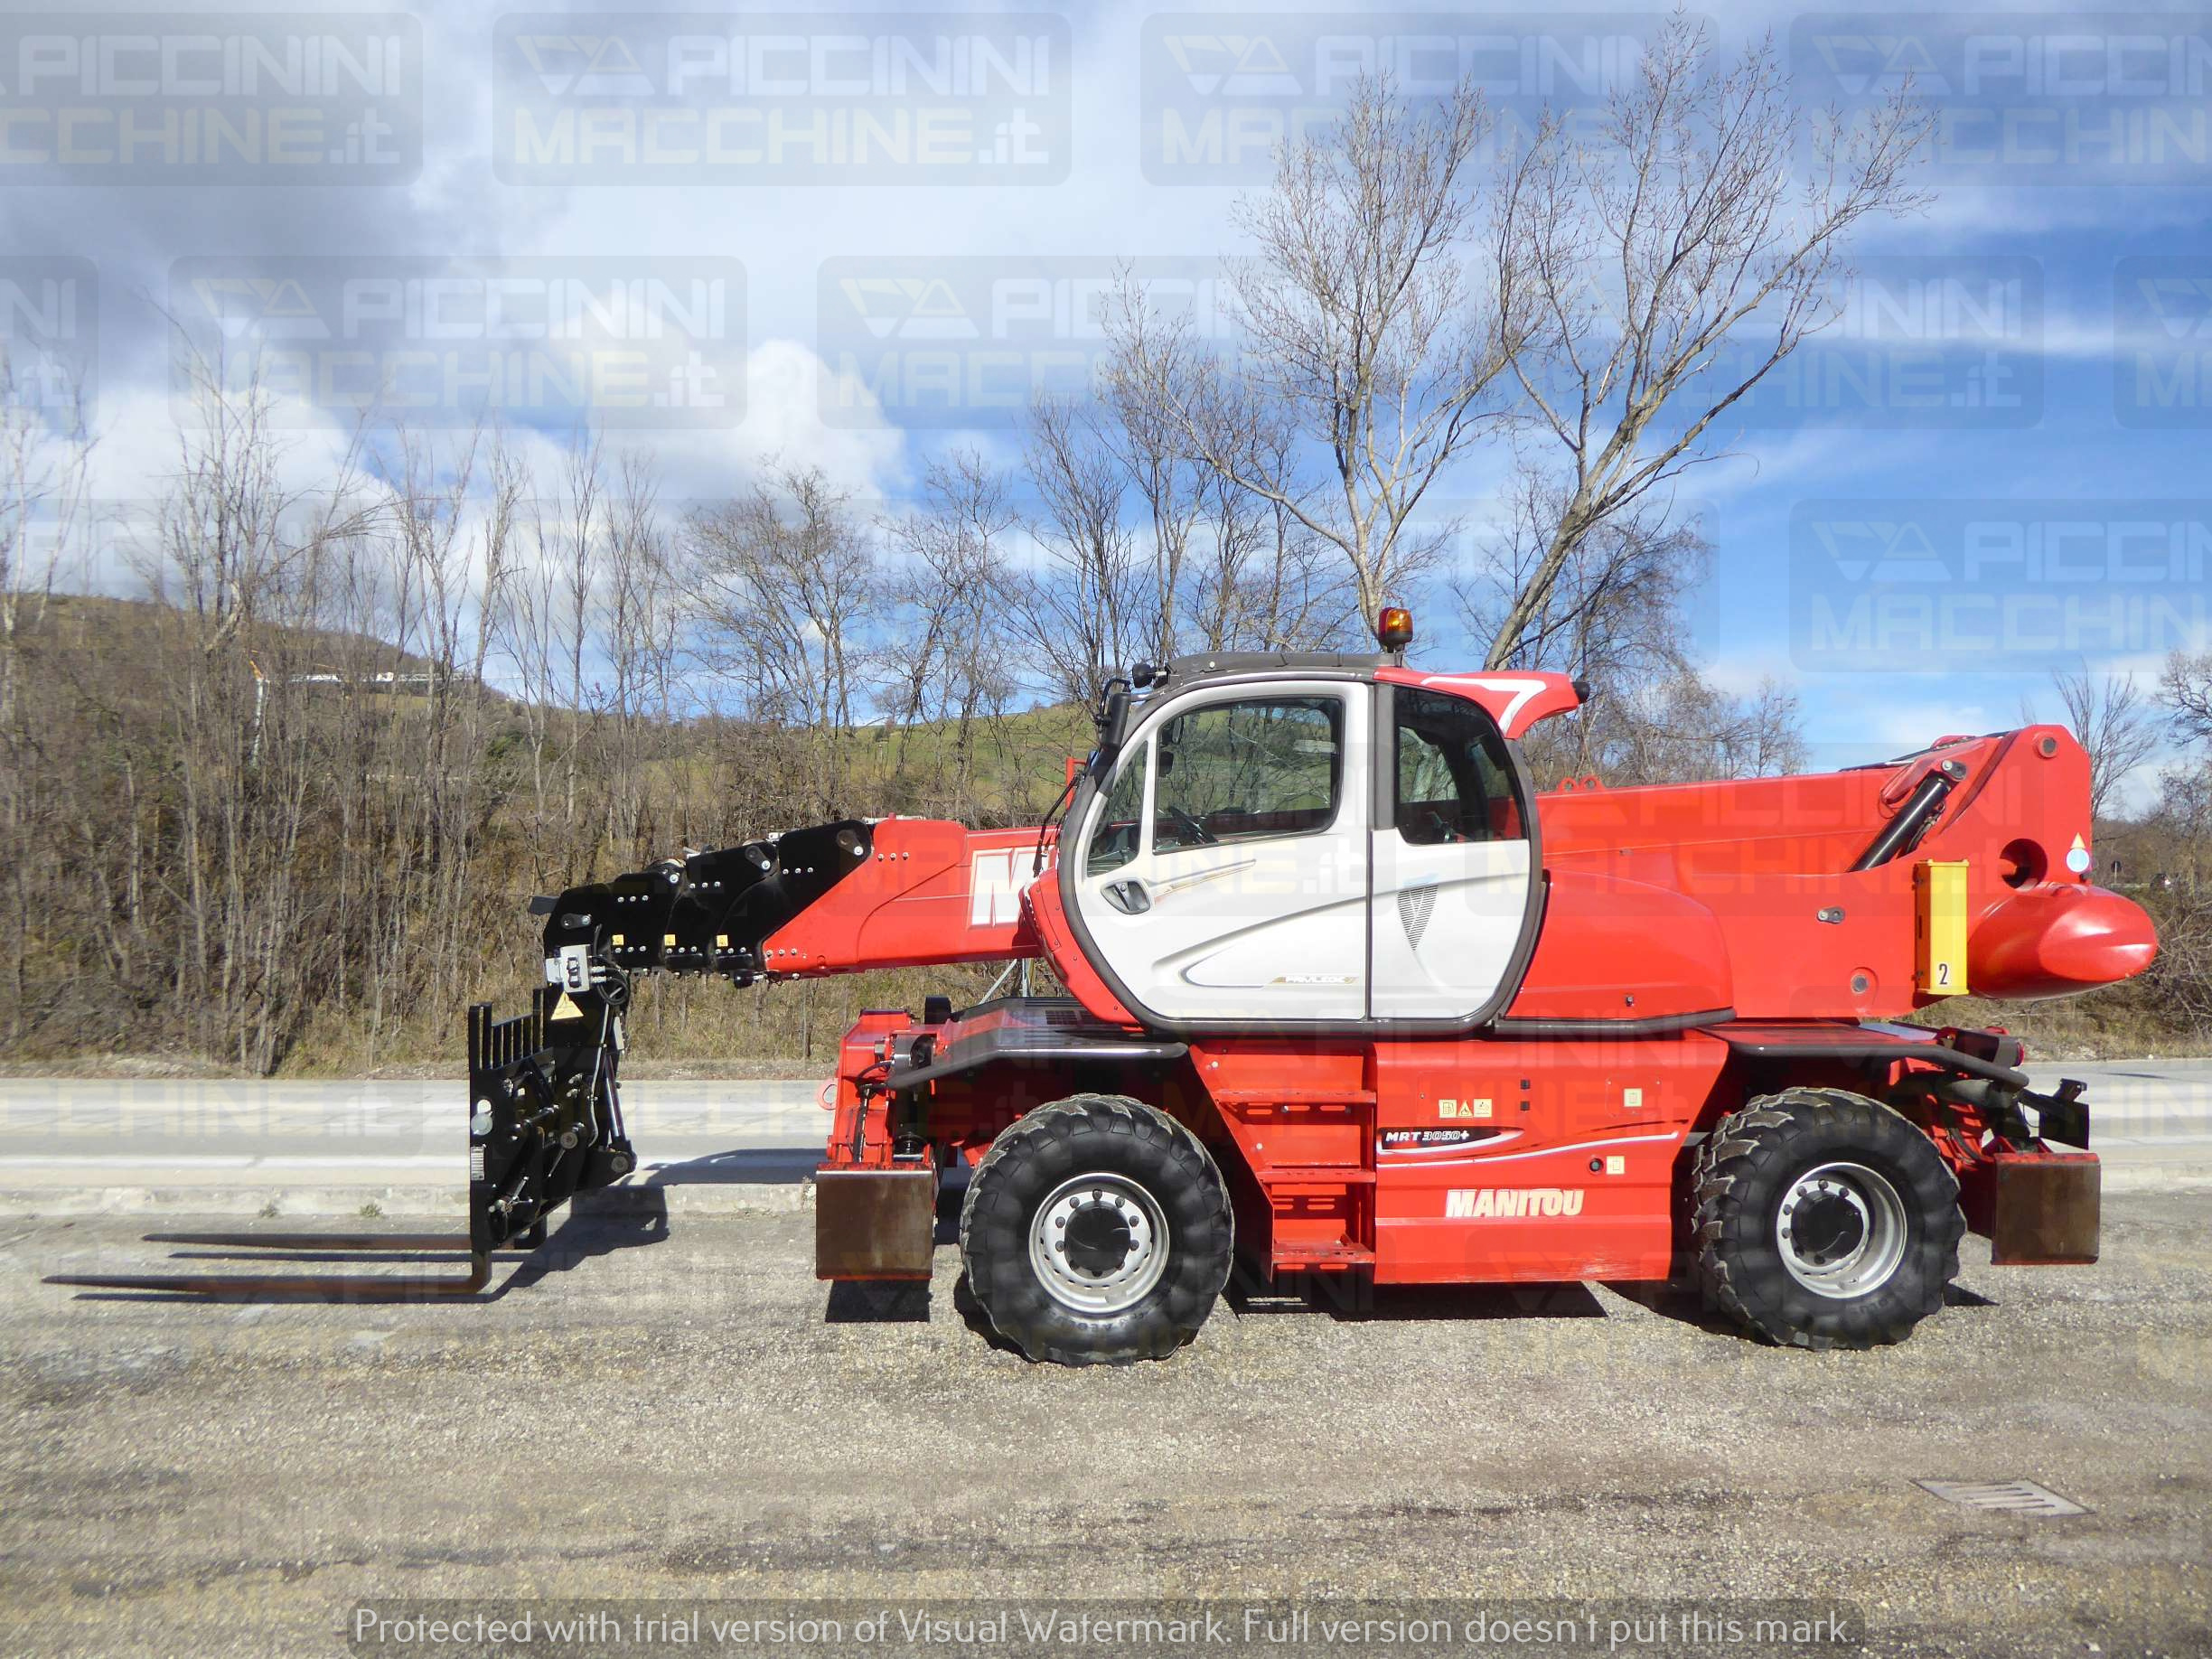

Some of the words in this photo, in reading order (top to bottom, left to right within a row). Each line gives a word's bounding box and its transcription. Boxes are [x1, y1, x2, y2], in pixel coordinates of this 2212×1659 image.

[1937, 963, 1949, 985] 2
[1384, 1131, 1421, 1142] MRT
[1421, 1129, 1470, 1141] 3050+
[1446, 1188, 1584, 1218] MANITOU
